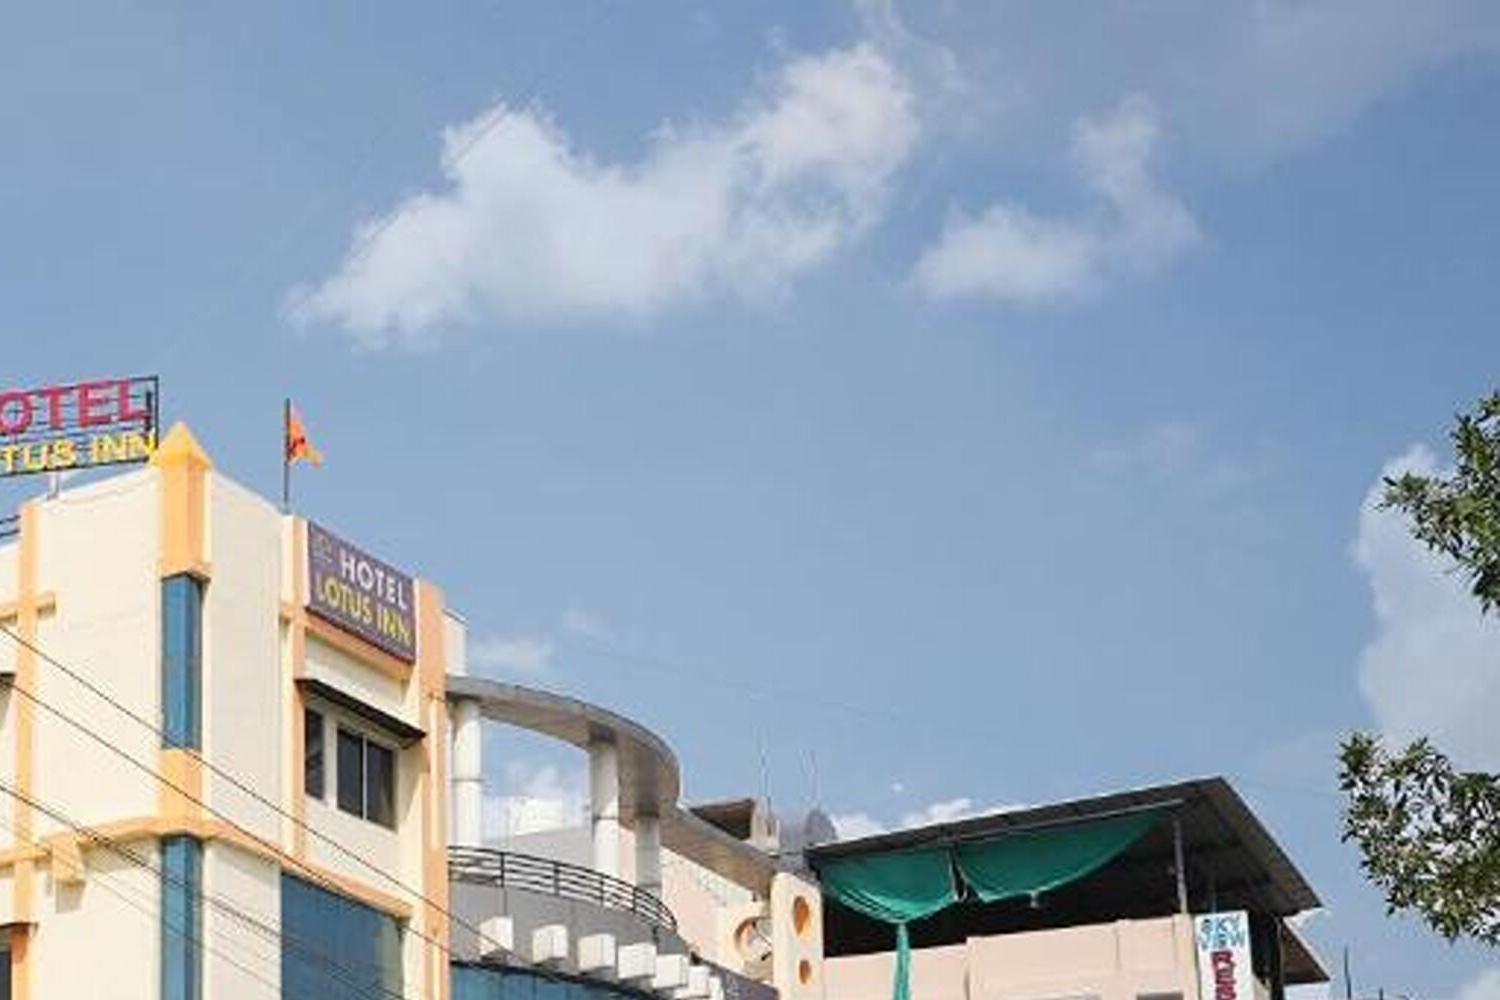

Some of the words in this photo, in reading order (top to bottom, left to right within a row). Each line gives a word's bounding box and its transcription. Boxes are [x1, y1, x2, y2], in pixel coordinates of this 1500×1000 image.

[92, 428, 156, 463] INN
[315, 572, 373, 624] LOTUS
[377, 603, 411, 646] INN
[340, 548, 408, 610] HOTEL
